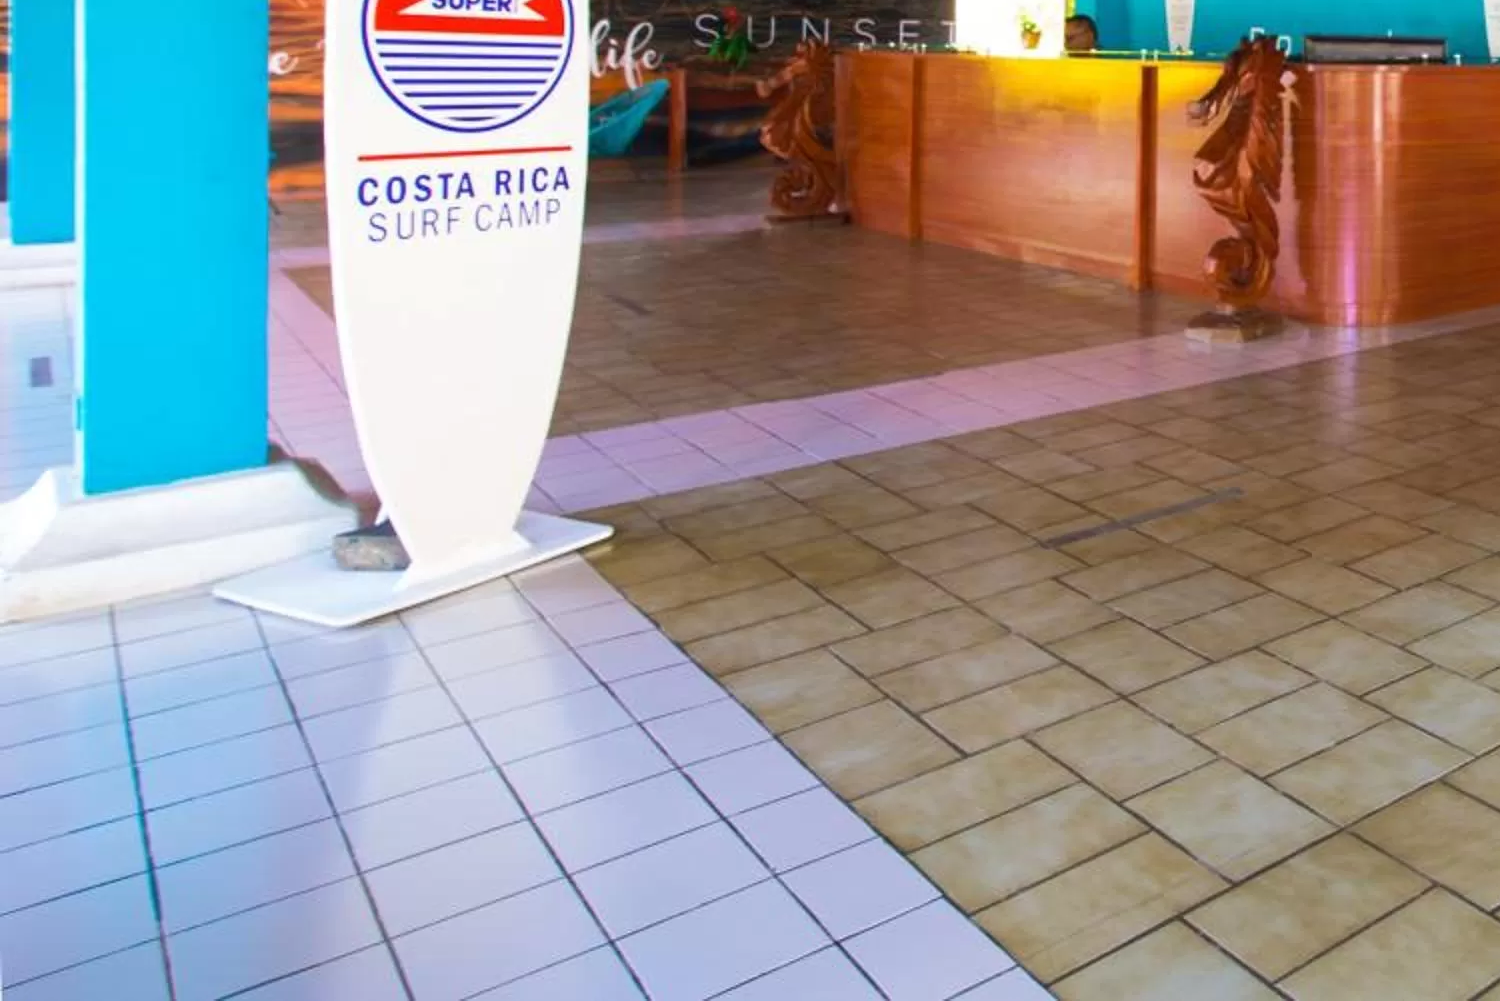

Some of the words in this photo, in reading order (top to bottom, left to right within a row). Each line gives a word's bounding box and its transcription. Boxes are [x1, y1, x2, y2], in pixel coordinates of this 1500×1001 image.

[588, 18, 664, 91] life
[357, 172, 475, 207] COSTA
[495, 165, 570, 196] RICA
[367, 206, 462, 243] SURF
[474, 198, 562, 233] CAMP
